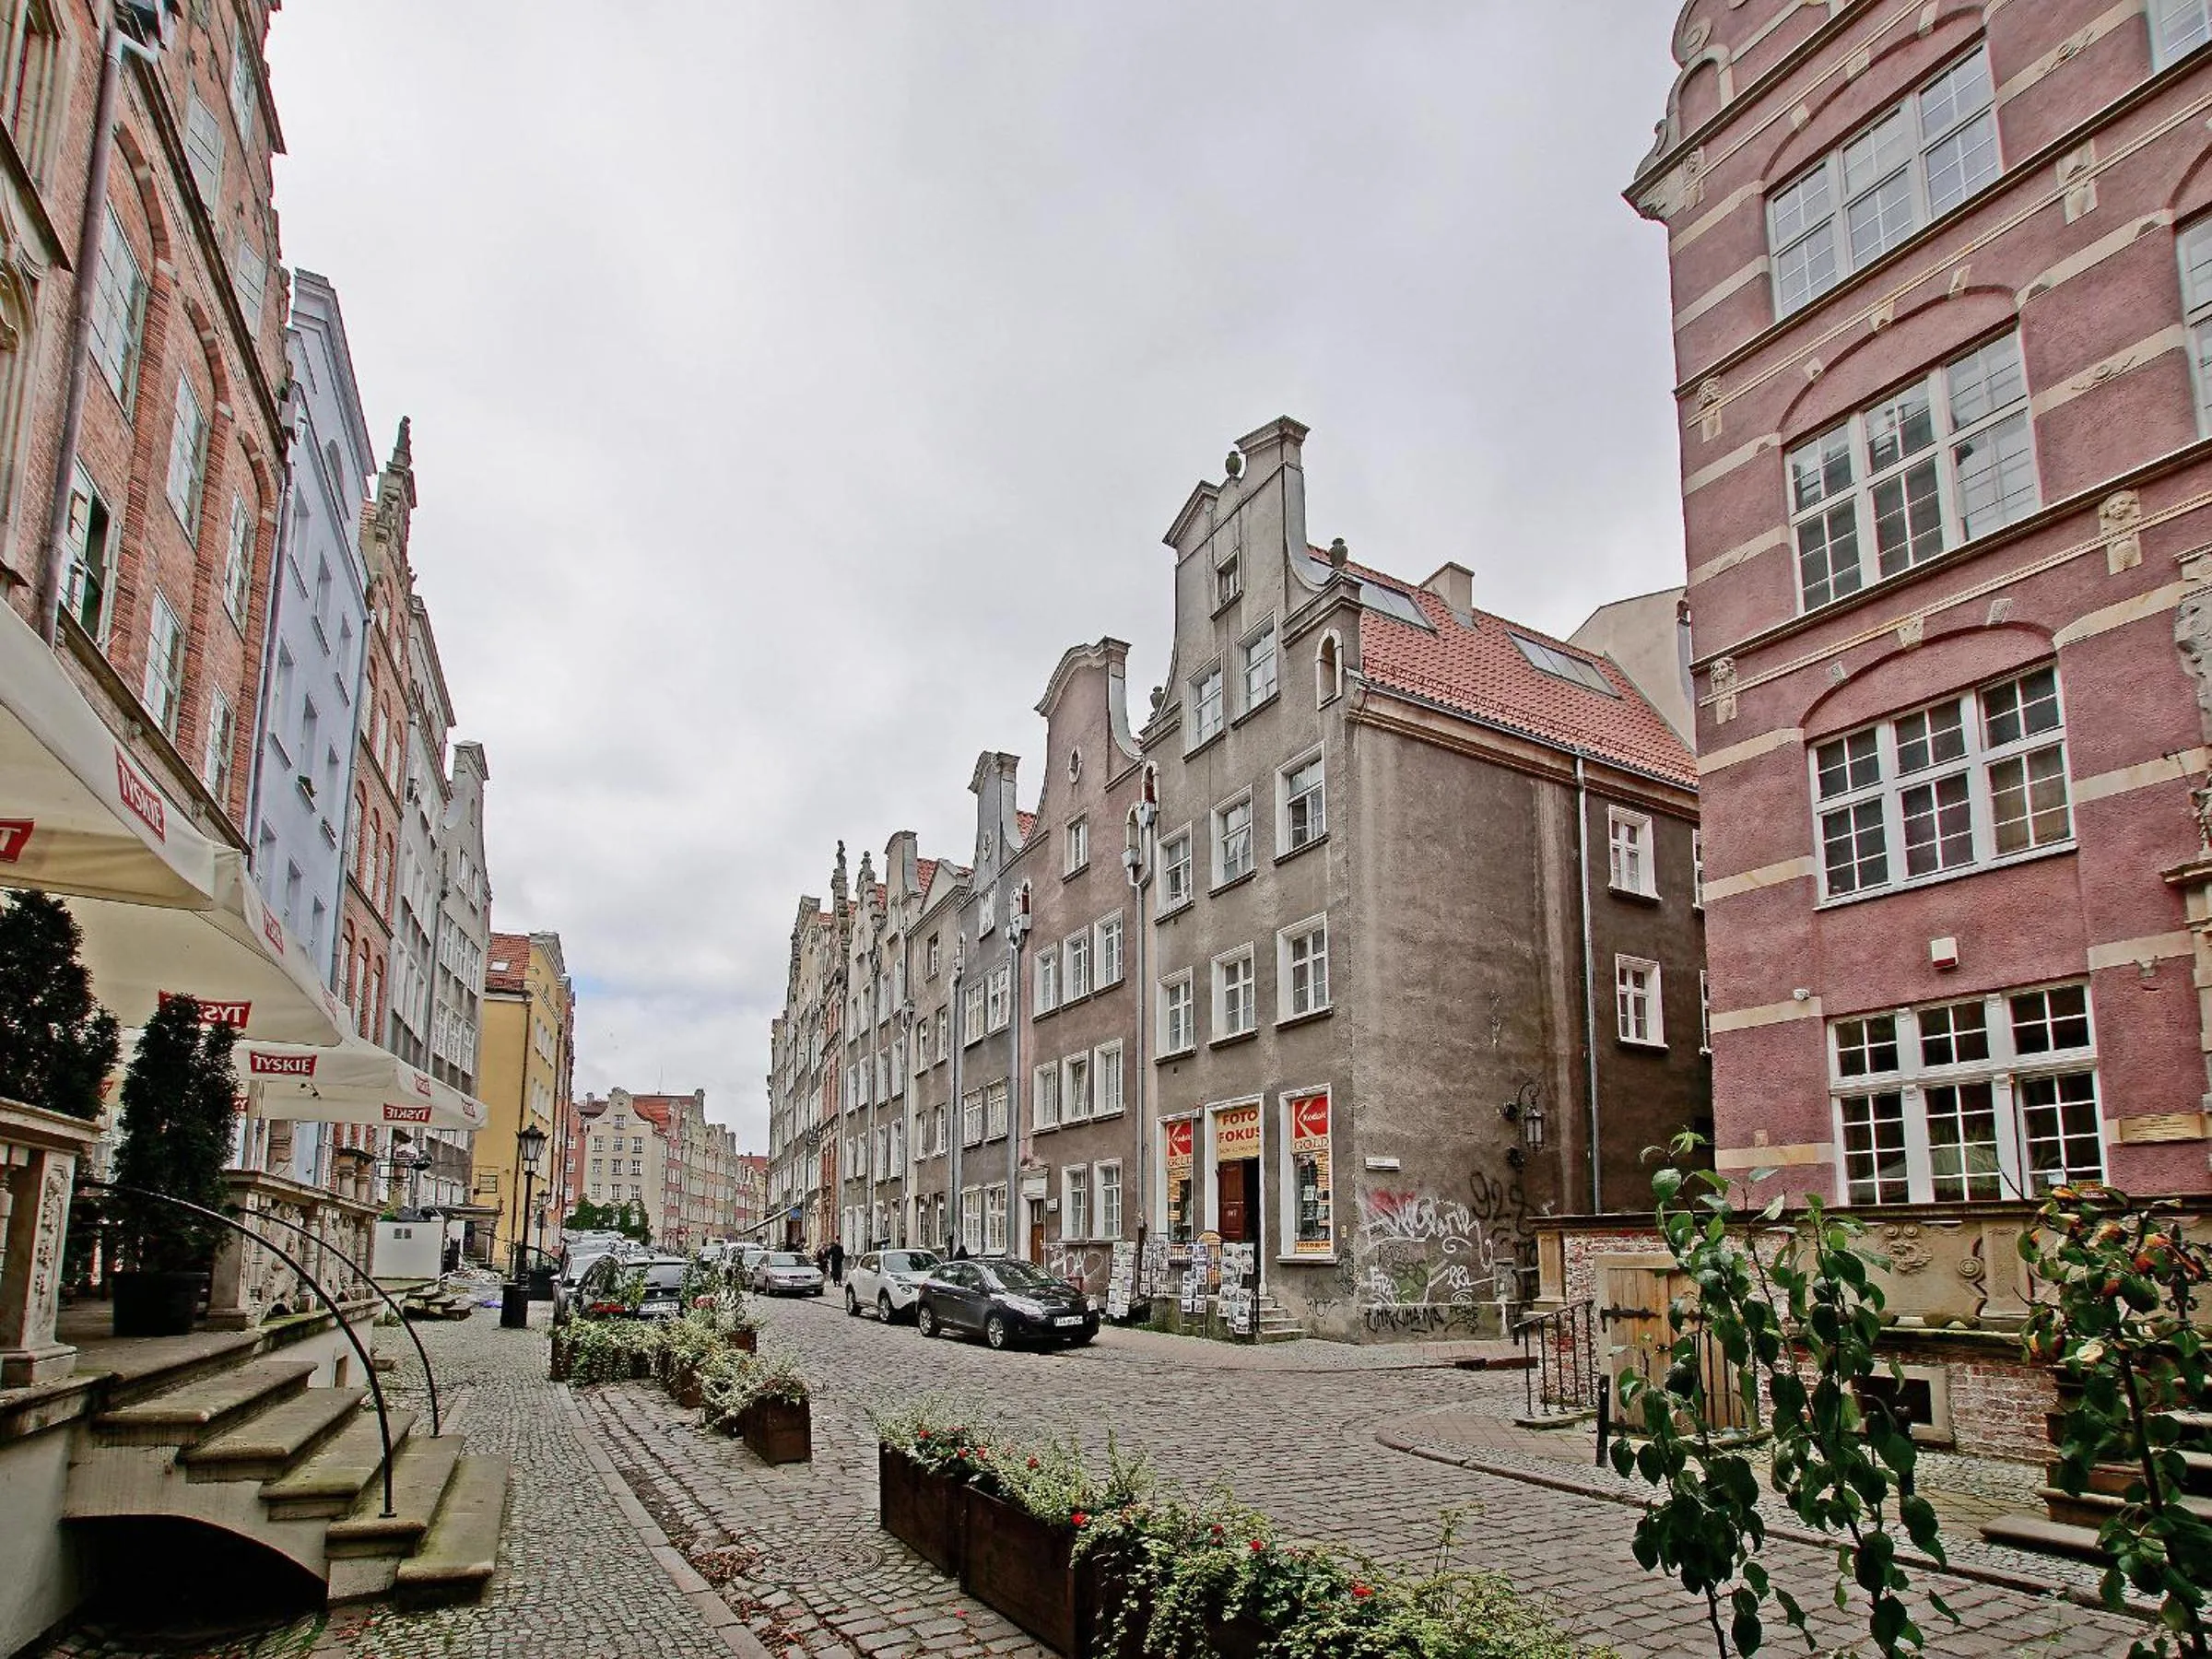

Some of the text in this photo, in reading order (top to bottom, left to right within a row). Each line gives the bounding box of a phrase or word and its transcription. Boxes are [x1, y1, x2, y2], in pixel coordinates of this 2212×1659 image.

[119, 759, 163, 833] TYSKIE
[253, 1055, 311, 1073] TYSKIE
[1223, 1110, 1258, 1125] FOTO
[1302, 1111, 1326, 1122] Kodak
[1295, 1136, 1329, 1150] GOLD
